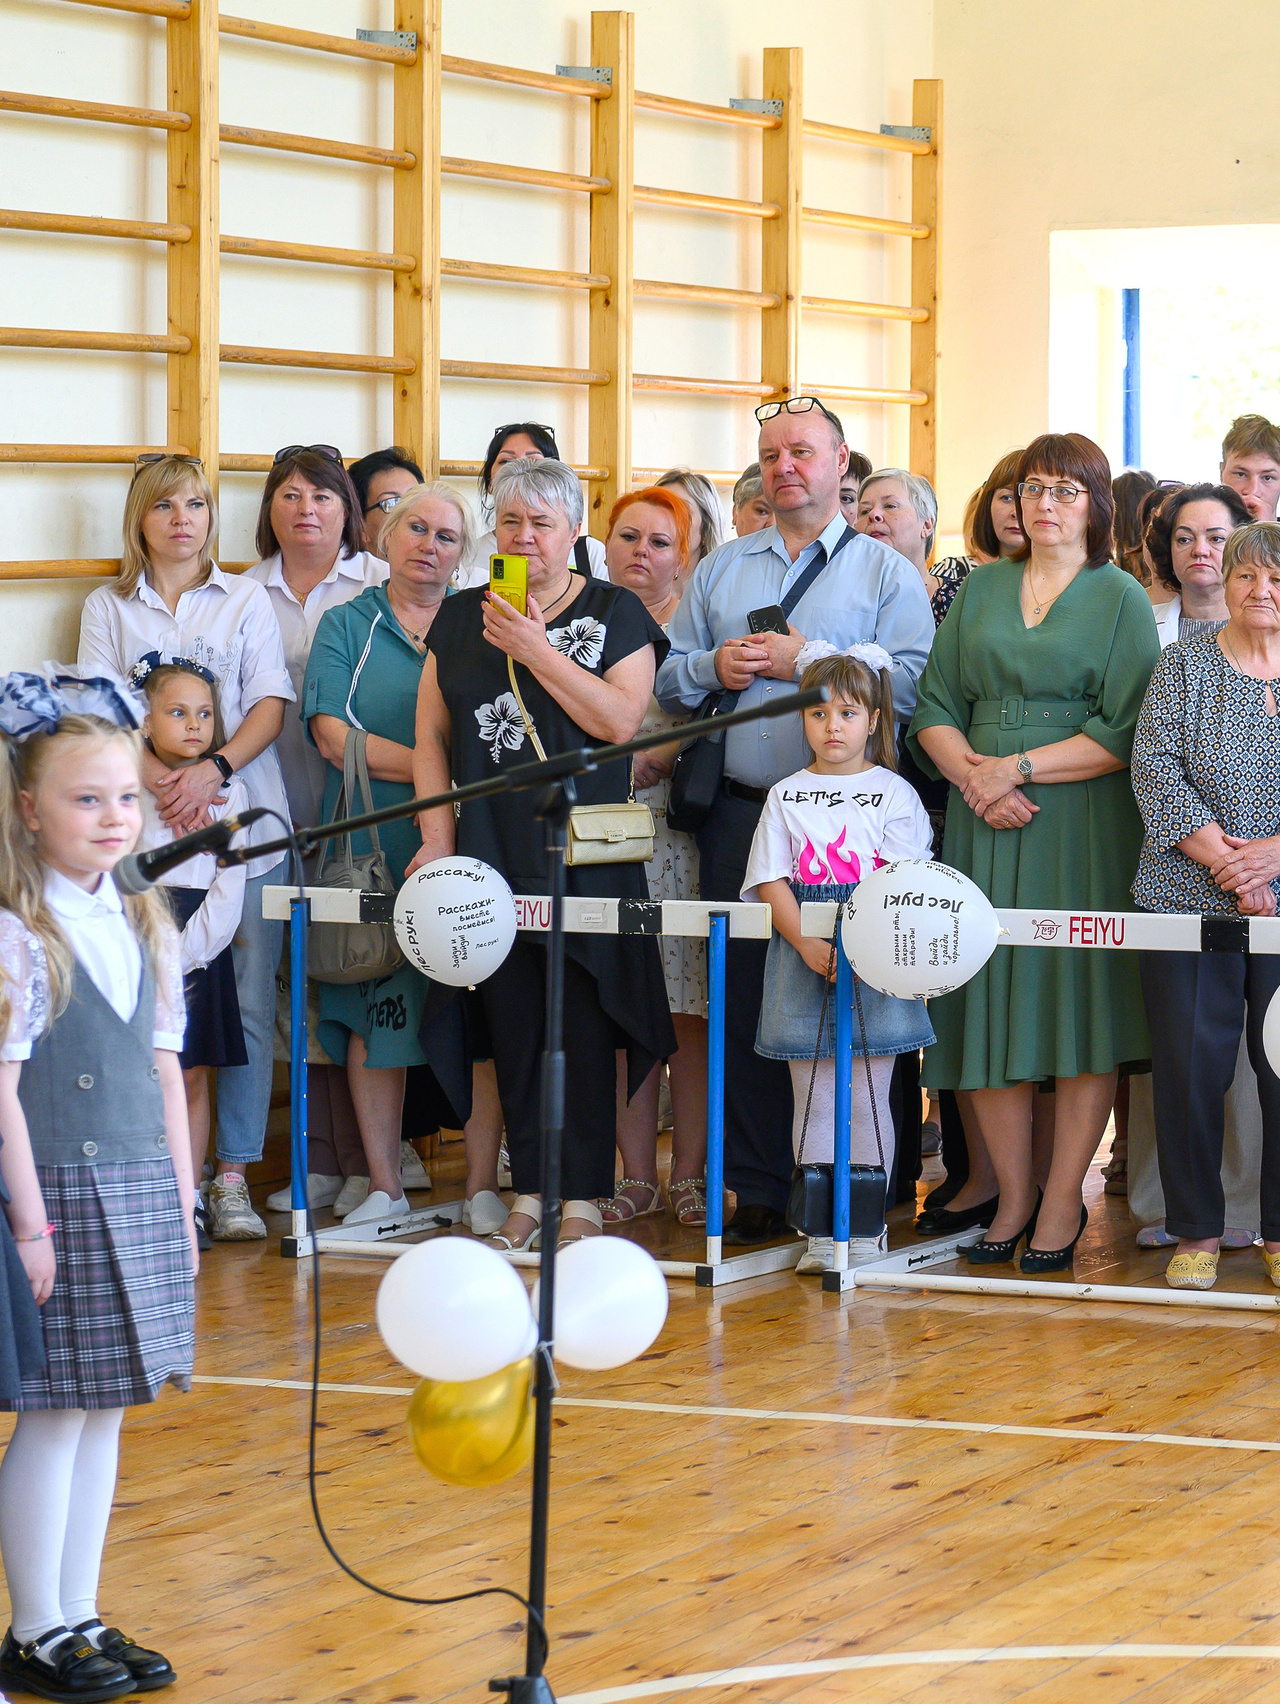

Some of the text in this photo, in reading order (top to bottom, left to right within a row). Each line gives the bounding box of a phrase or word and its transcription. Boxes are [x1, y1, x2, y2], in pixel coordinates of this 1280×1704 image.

[782, 790, 884, 808] LET'S GO
[418, 869, 485, 883] Рассажу!
[516, 900, 550, 929] EIYU
[883, 892, 964, 913] Лес рук!
[460, 909, 490, 922] вместе
[405, 910, 436, 973] Лес рук!
[1070, 916, 1125, 946] FEIYU
[928, 937, 940, 967] Выйди
